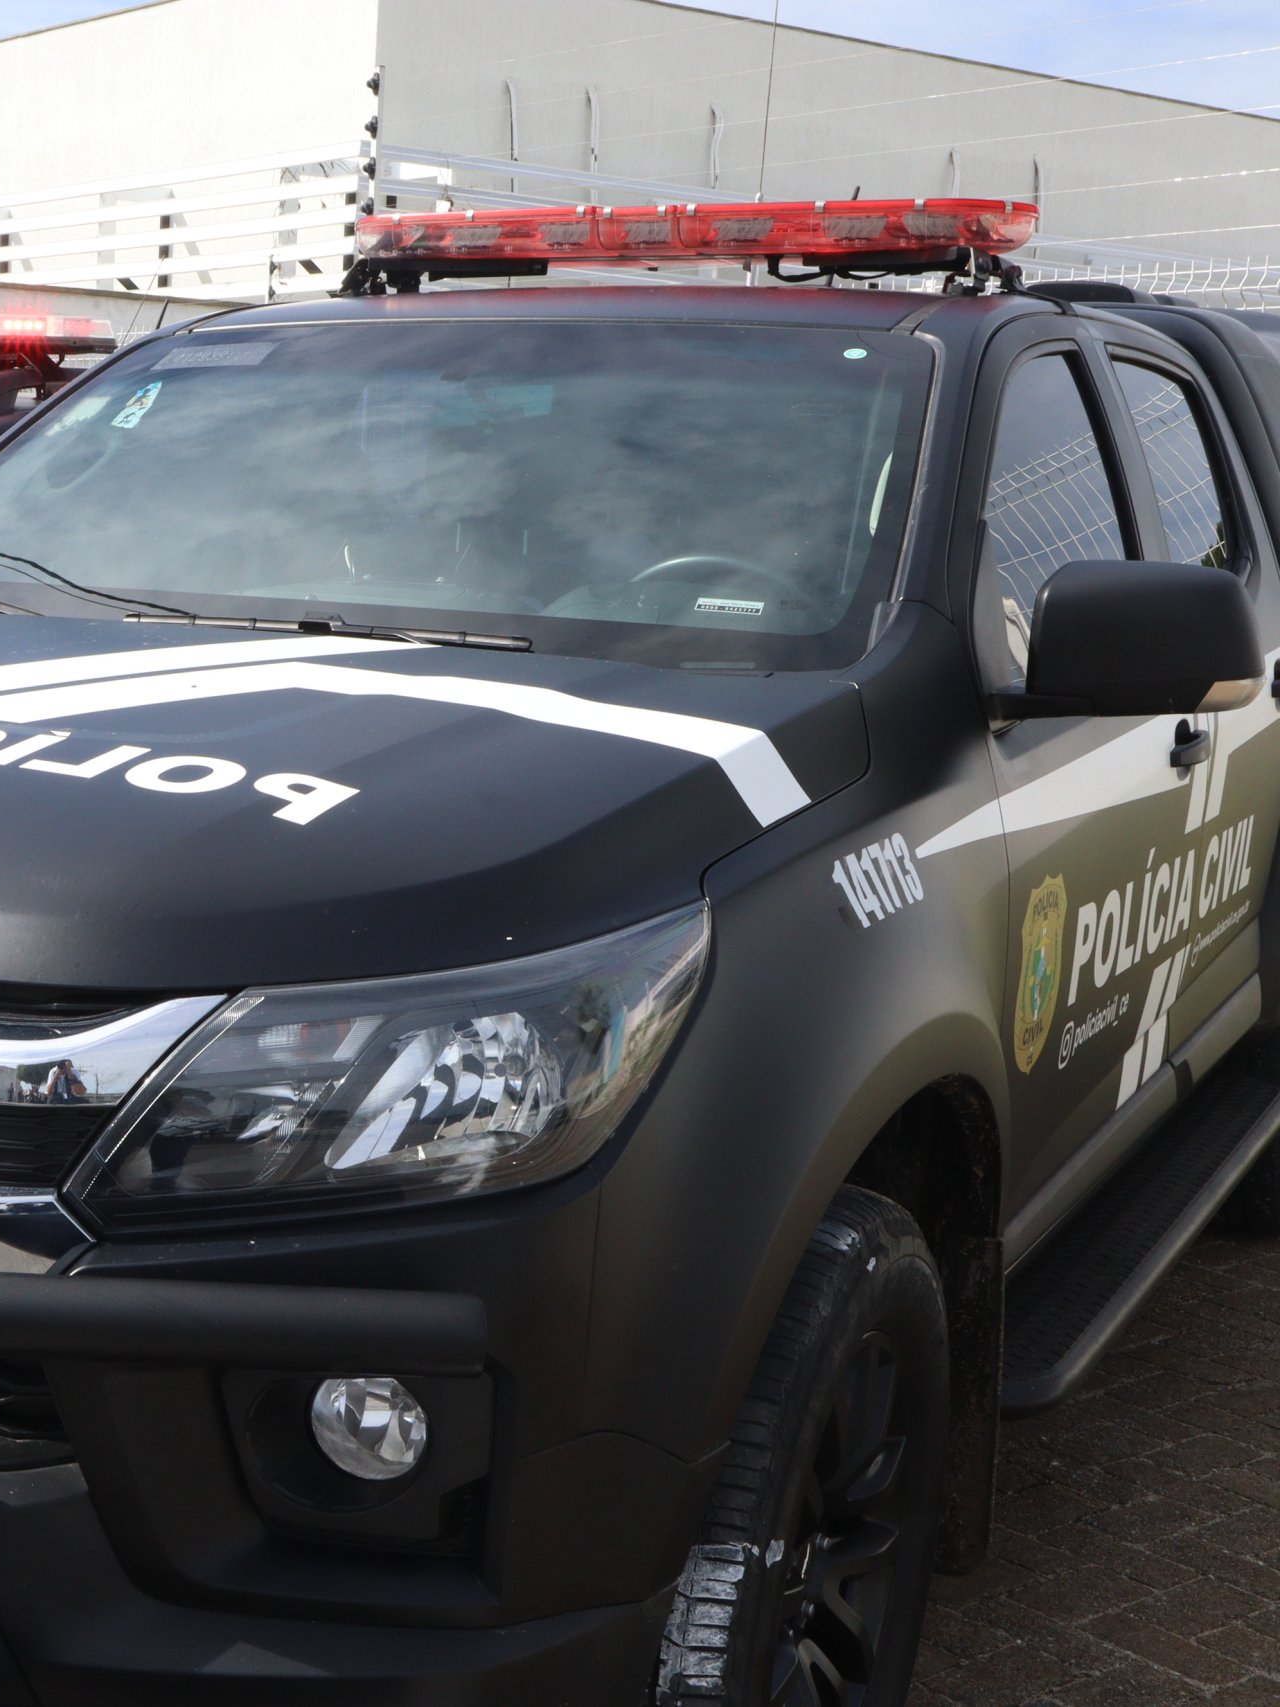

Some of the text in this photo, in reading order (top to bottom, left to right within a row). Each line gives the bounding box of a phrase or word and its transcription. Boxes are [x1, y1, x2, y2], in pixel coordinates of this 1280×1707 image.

[1067, 814, 1255, 1007] POLÍCIA CIVIL
[1022, 1020, 1044, 1046] CIVIL
